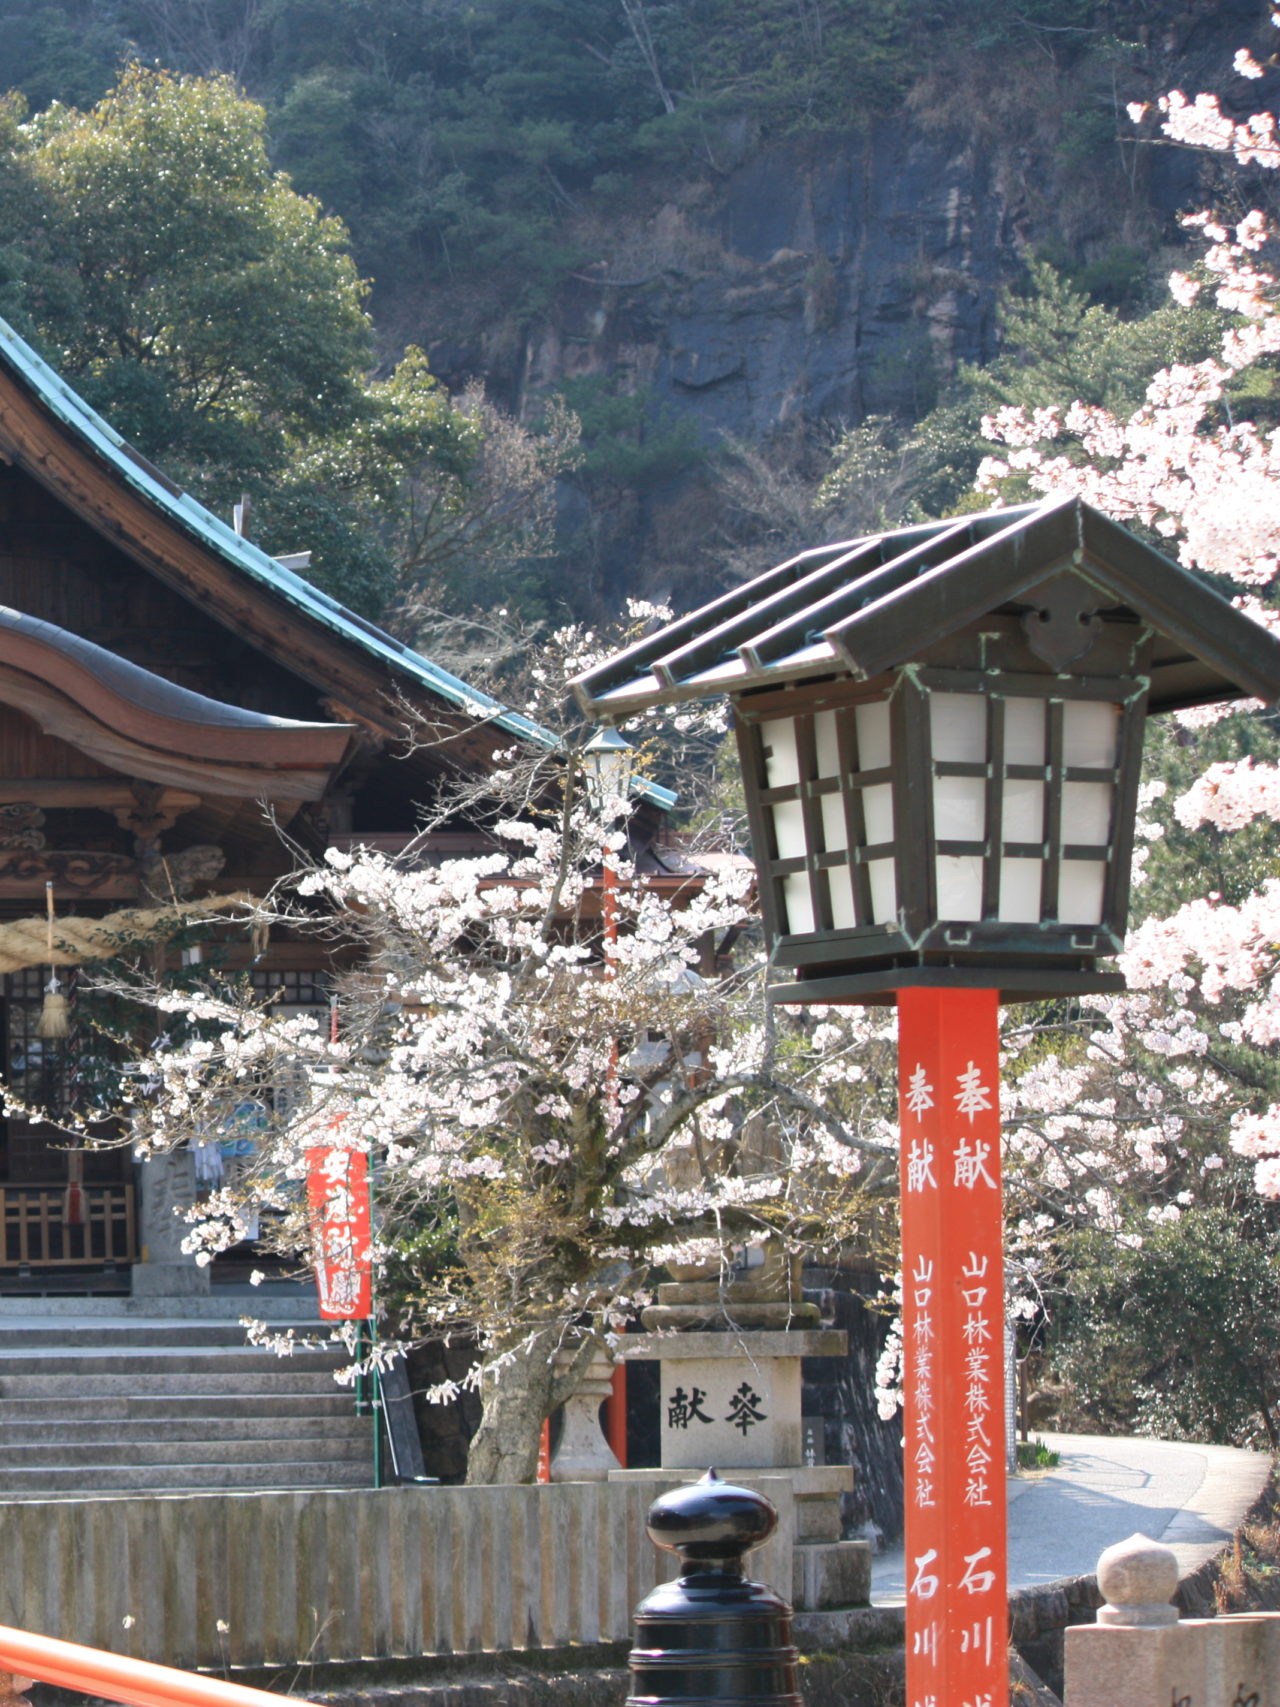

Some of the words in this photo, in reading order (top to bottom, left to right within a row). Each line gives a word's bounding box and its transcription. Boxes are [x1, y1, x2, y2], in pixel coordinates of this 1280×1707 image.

[905, 1062, 937, 1193] 奉献
[953, 1060, 998, 1190] 奉献
[911, 1254, 936, 1508] 山口林業株式会社
[961, 1251, 993, 1507] 山口林業株式会社
[910, 1548, 939, 1707] 石川
[958, 1546, 996, 1707] 石川
